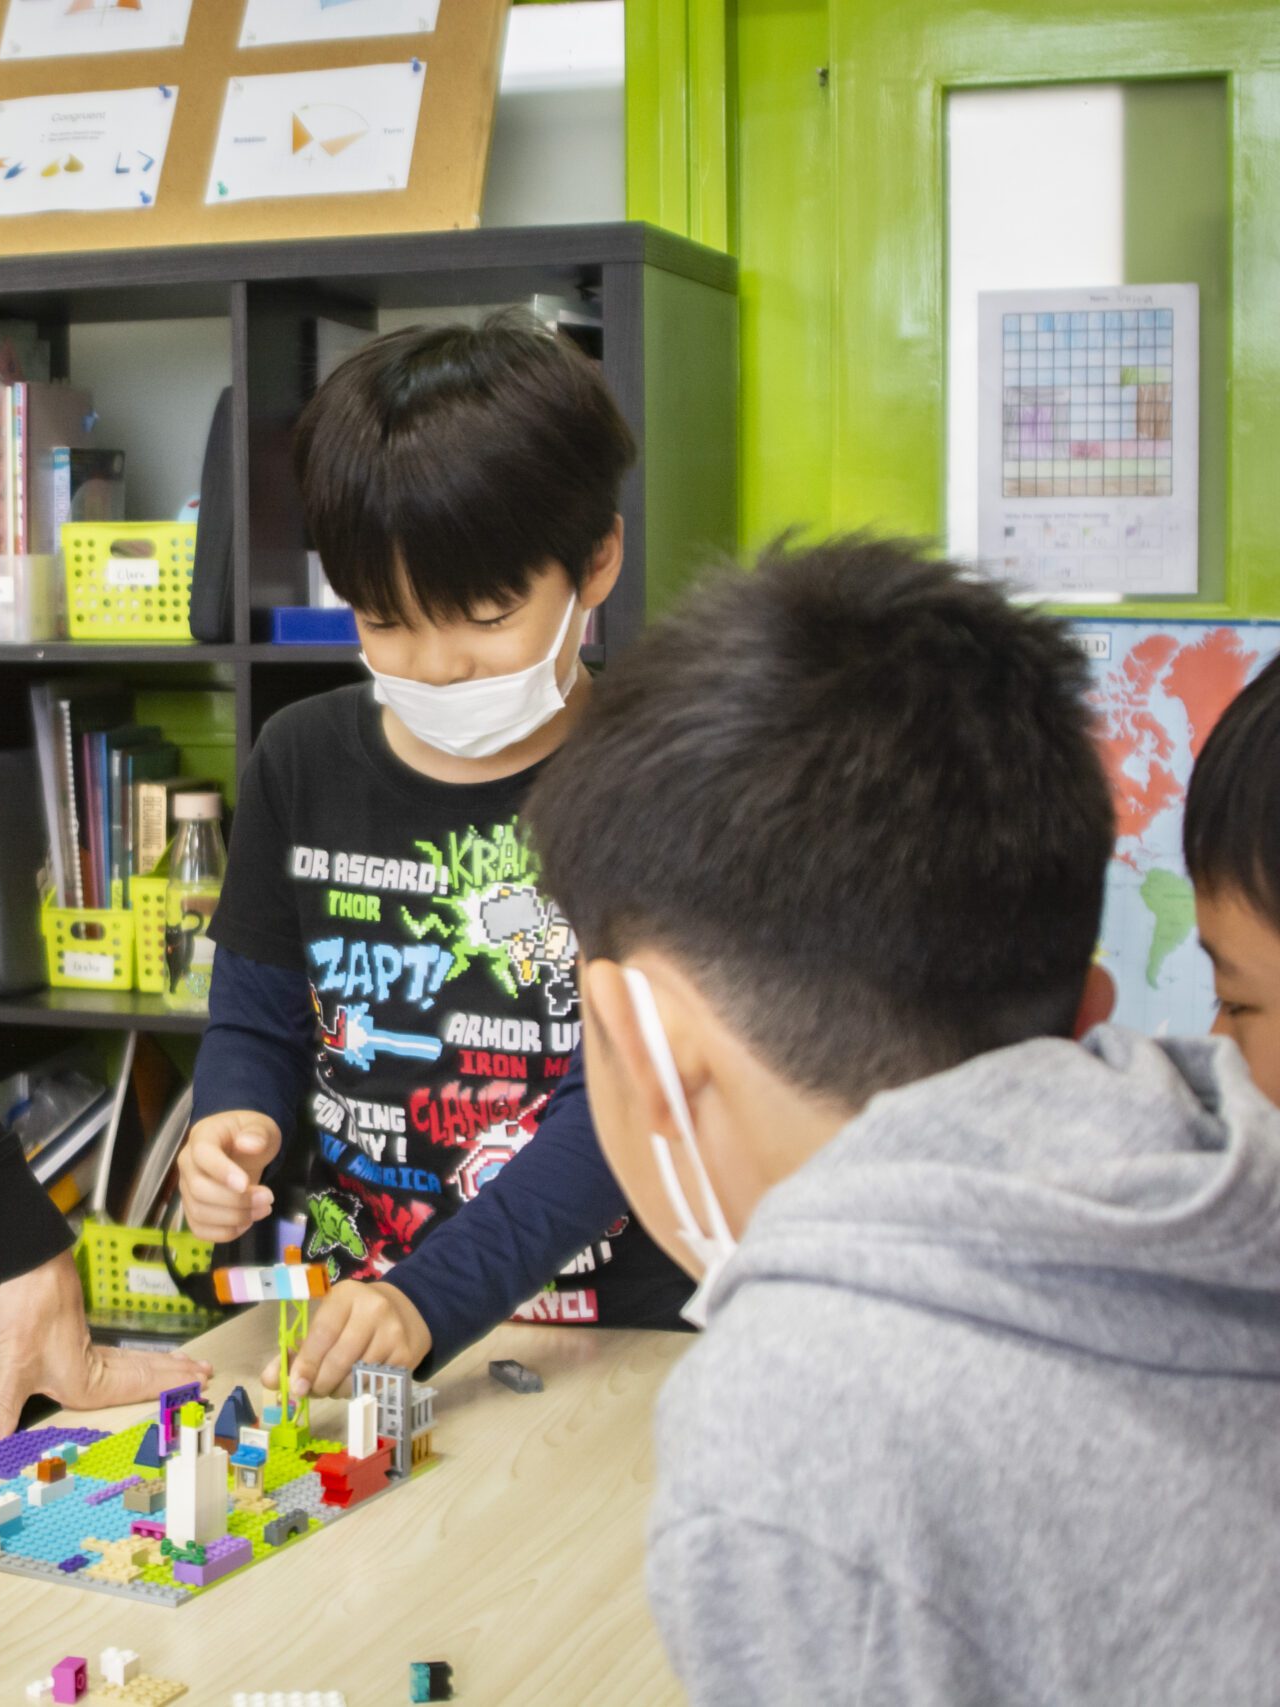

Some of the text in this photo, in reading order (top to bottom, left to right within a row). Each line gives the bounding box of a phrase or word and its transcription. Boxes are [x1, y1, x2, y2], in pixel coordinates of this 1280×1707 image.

[328, 889, 382, 922] THOR
[445, 1012, 542, 1052] ARMOR
[458, 1050, 528, 1079] IRON
